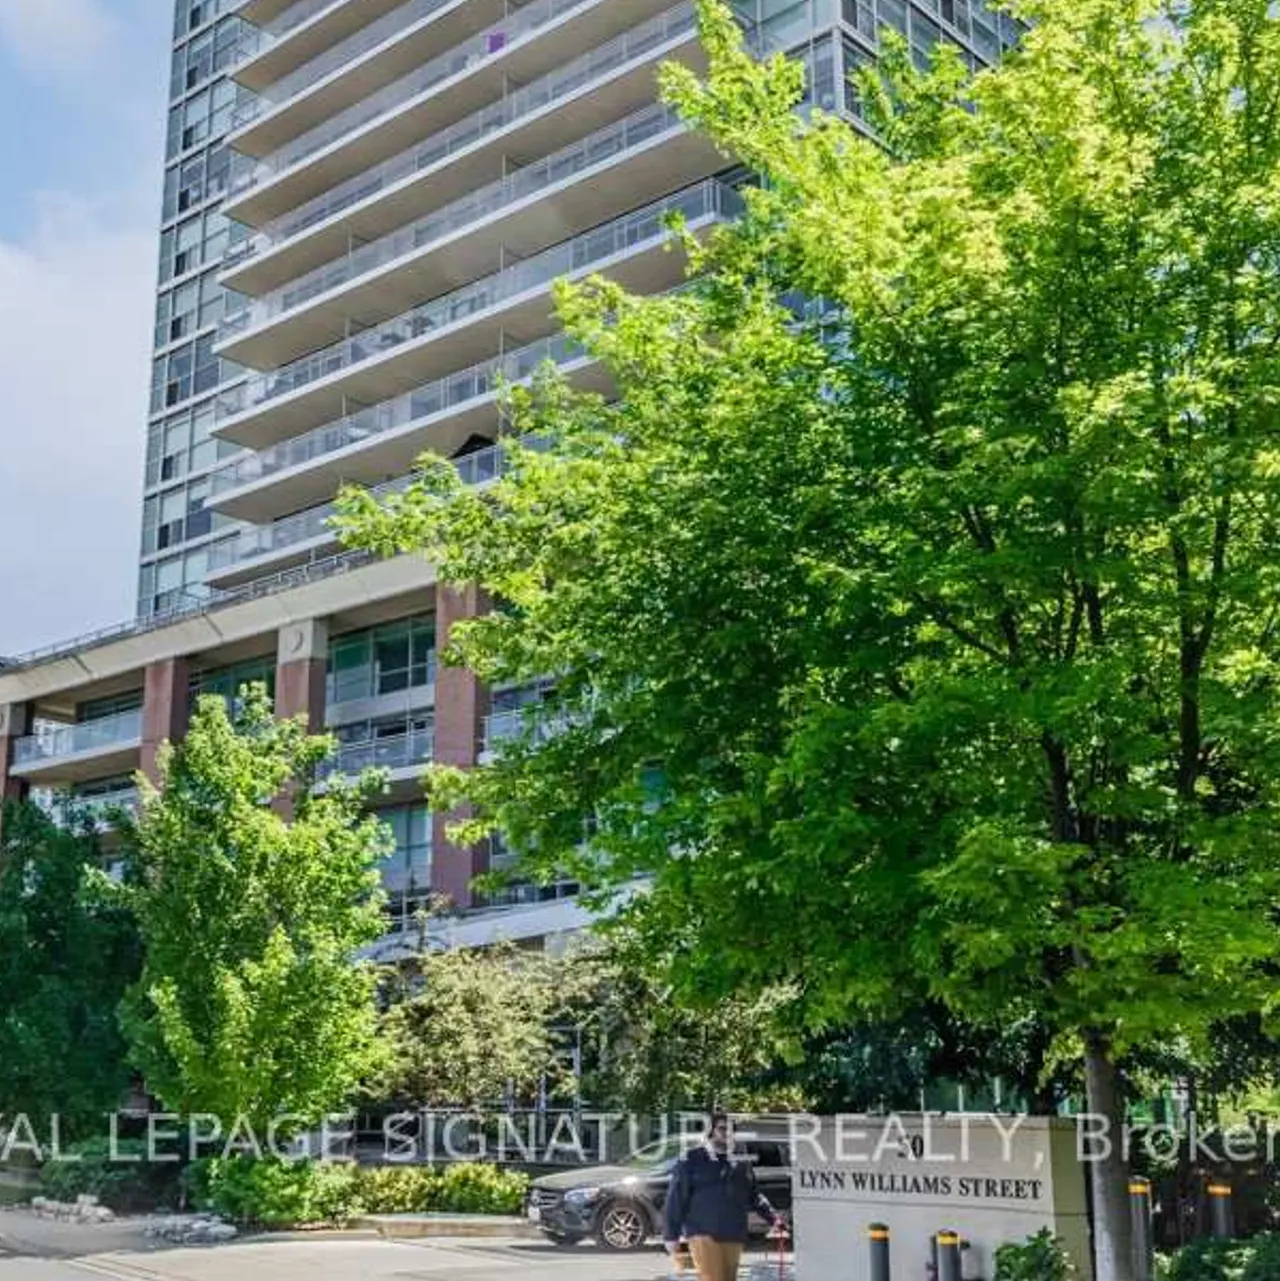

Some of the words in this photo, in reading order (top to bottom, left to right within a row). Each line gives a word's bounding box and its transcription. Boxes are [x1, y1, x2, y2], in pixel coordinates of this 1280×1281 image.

[799, 1170, 846, 1190] LYNN
[851, 1172, 952, 1195] WILLIAMS
[958, 1177, 1042, 1200] STREET
